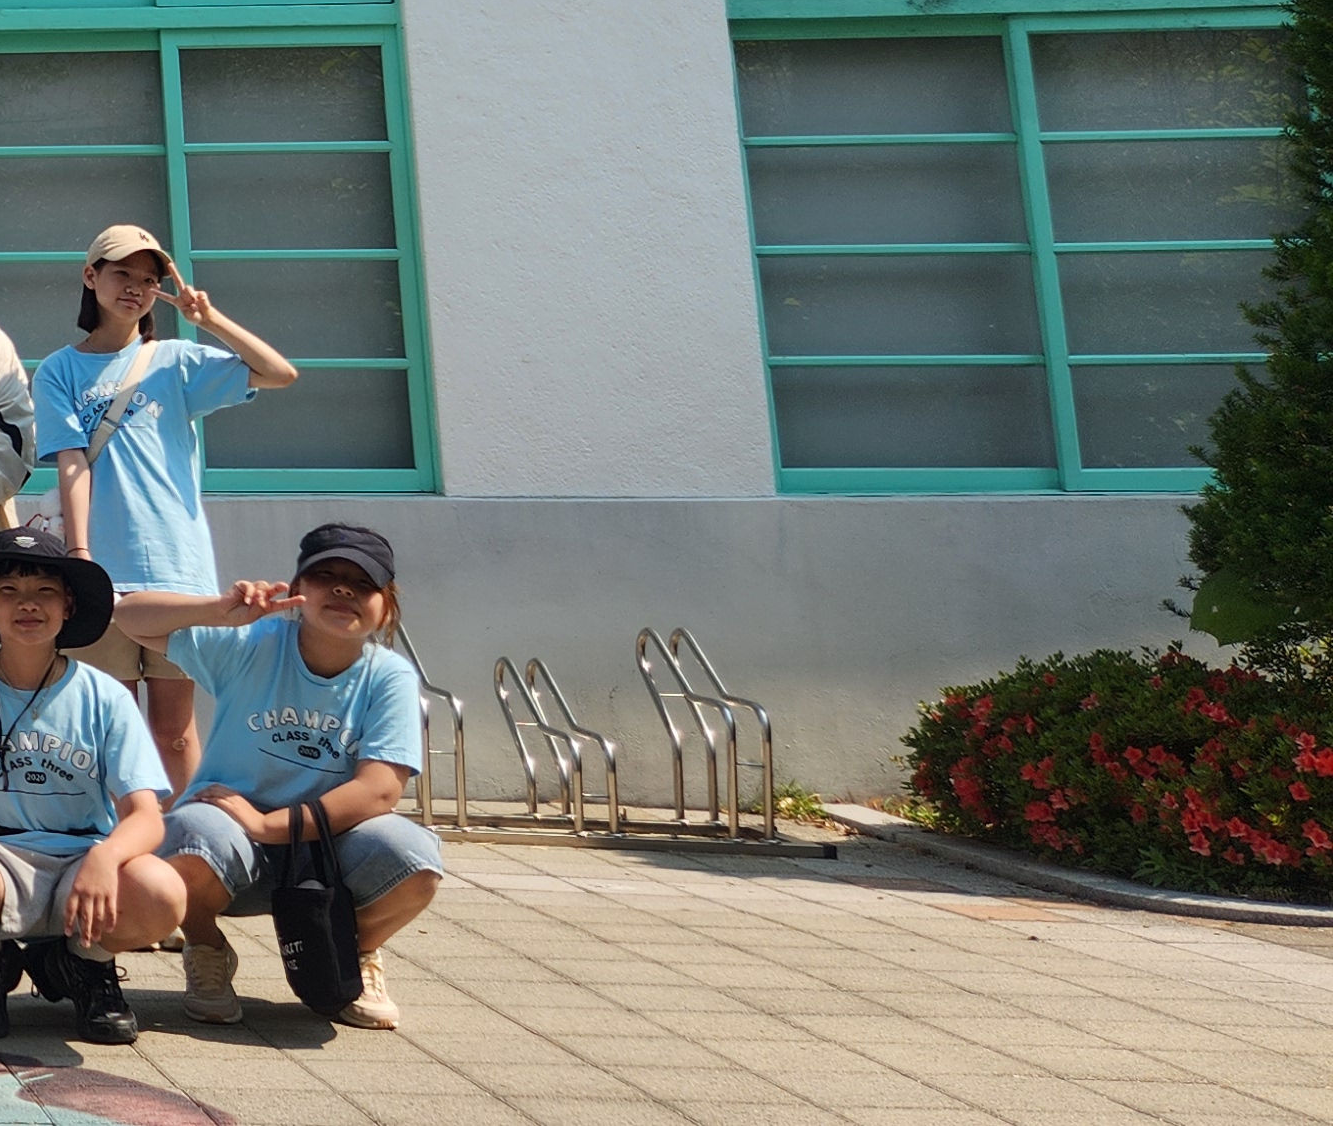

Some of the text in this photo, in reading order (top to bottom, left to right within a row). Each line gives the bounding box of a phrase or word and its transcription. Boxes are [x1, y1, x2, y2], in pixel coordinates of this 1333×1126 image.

[272, 729, 310, 744] CLASS
[41, 754, 74, 781] three
[26, 772, 46, 783] 2026
